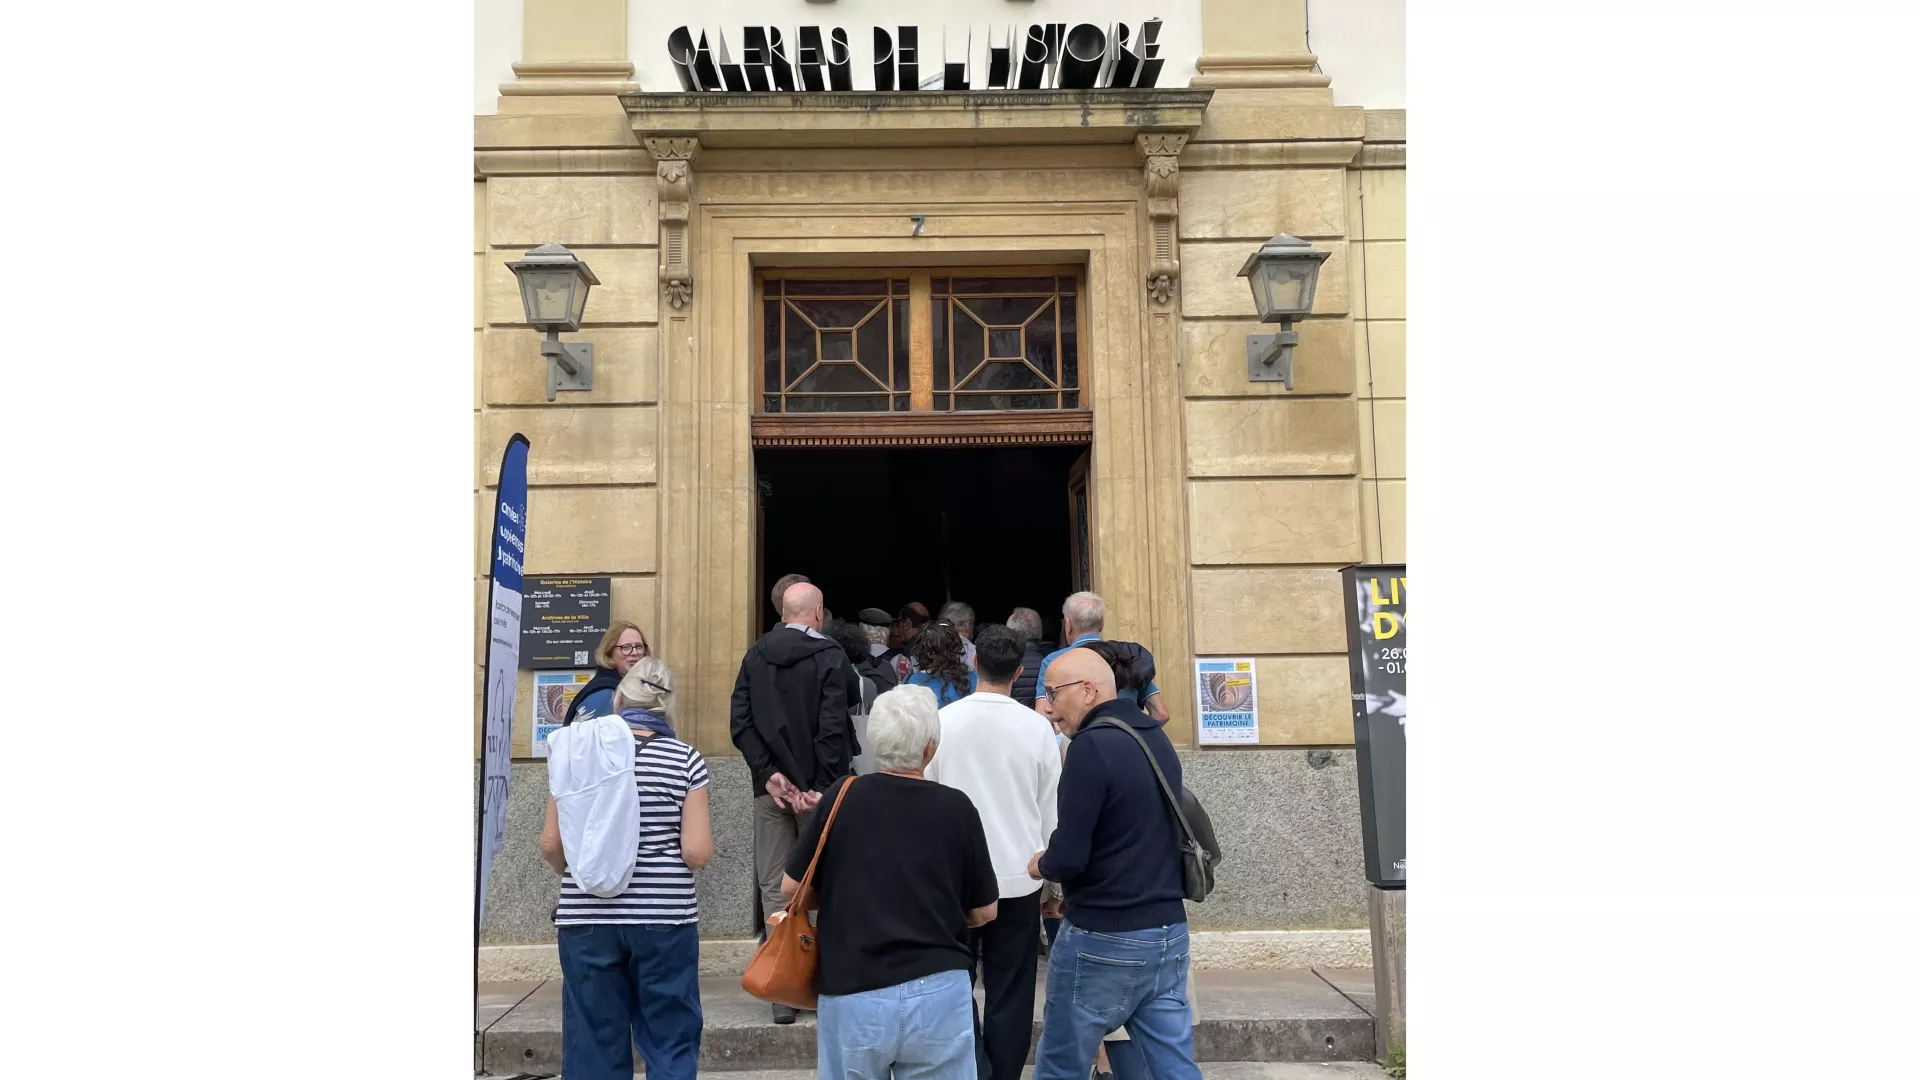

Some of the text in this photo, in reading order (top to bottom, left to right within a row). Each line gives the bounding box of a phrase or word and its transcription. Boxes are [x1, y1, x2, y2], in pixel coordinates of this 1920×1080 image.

[872, 25, 919, 89] DE
[910, 214, 924, 237] 7
[1387, 661, 1406, 674] 01.
[1204, 713, 1242, 721] DÉCOUVRIR
